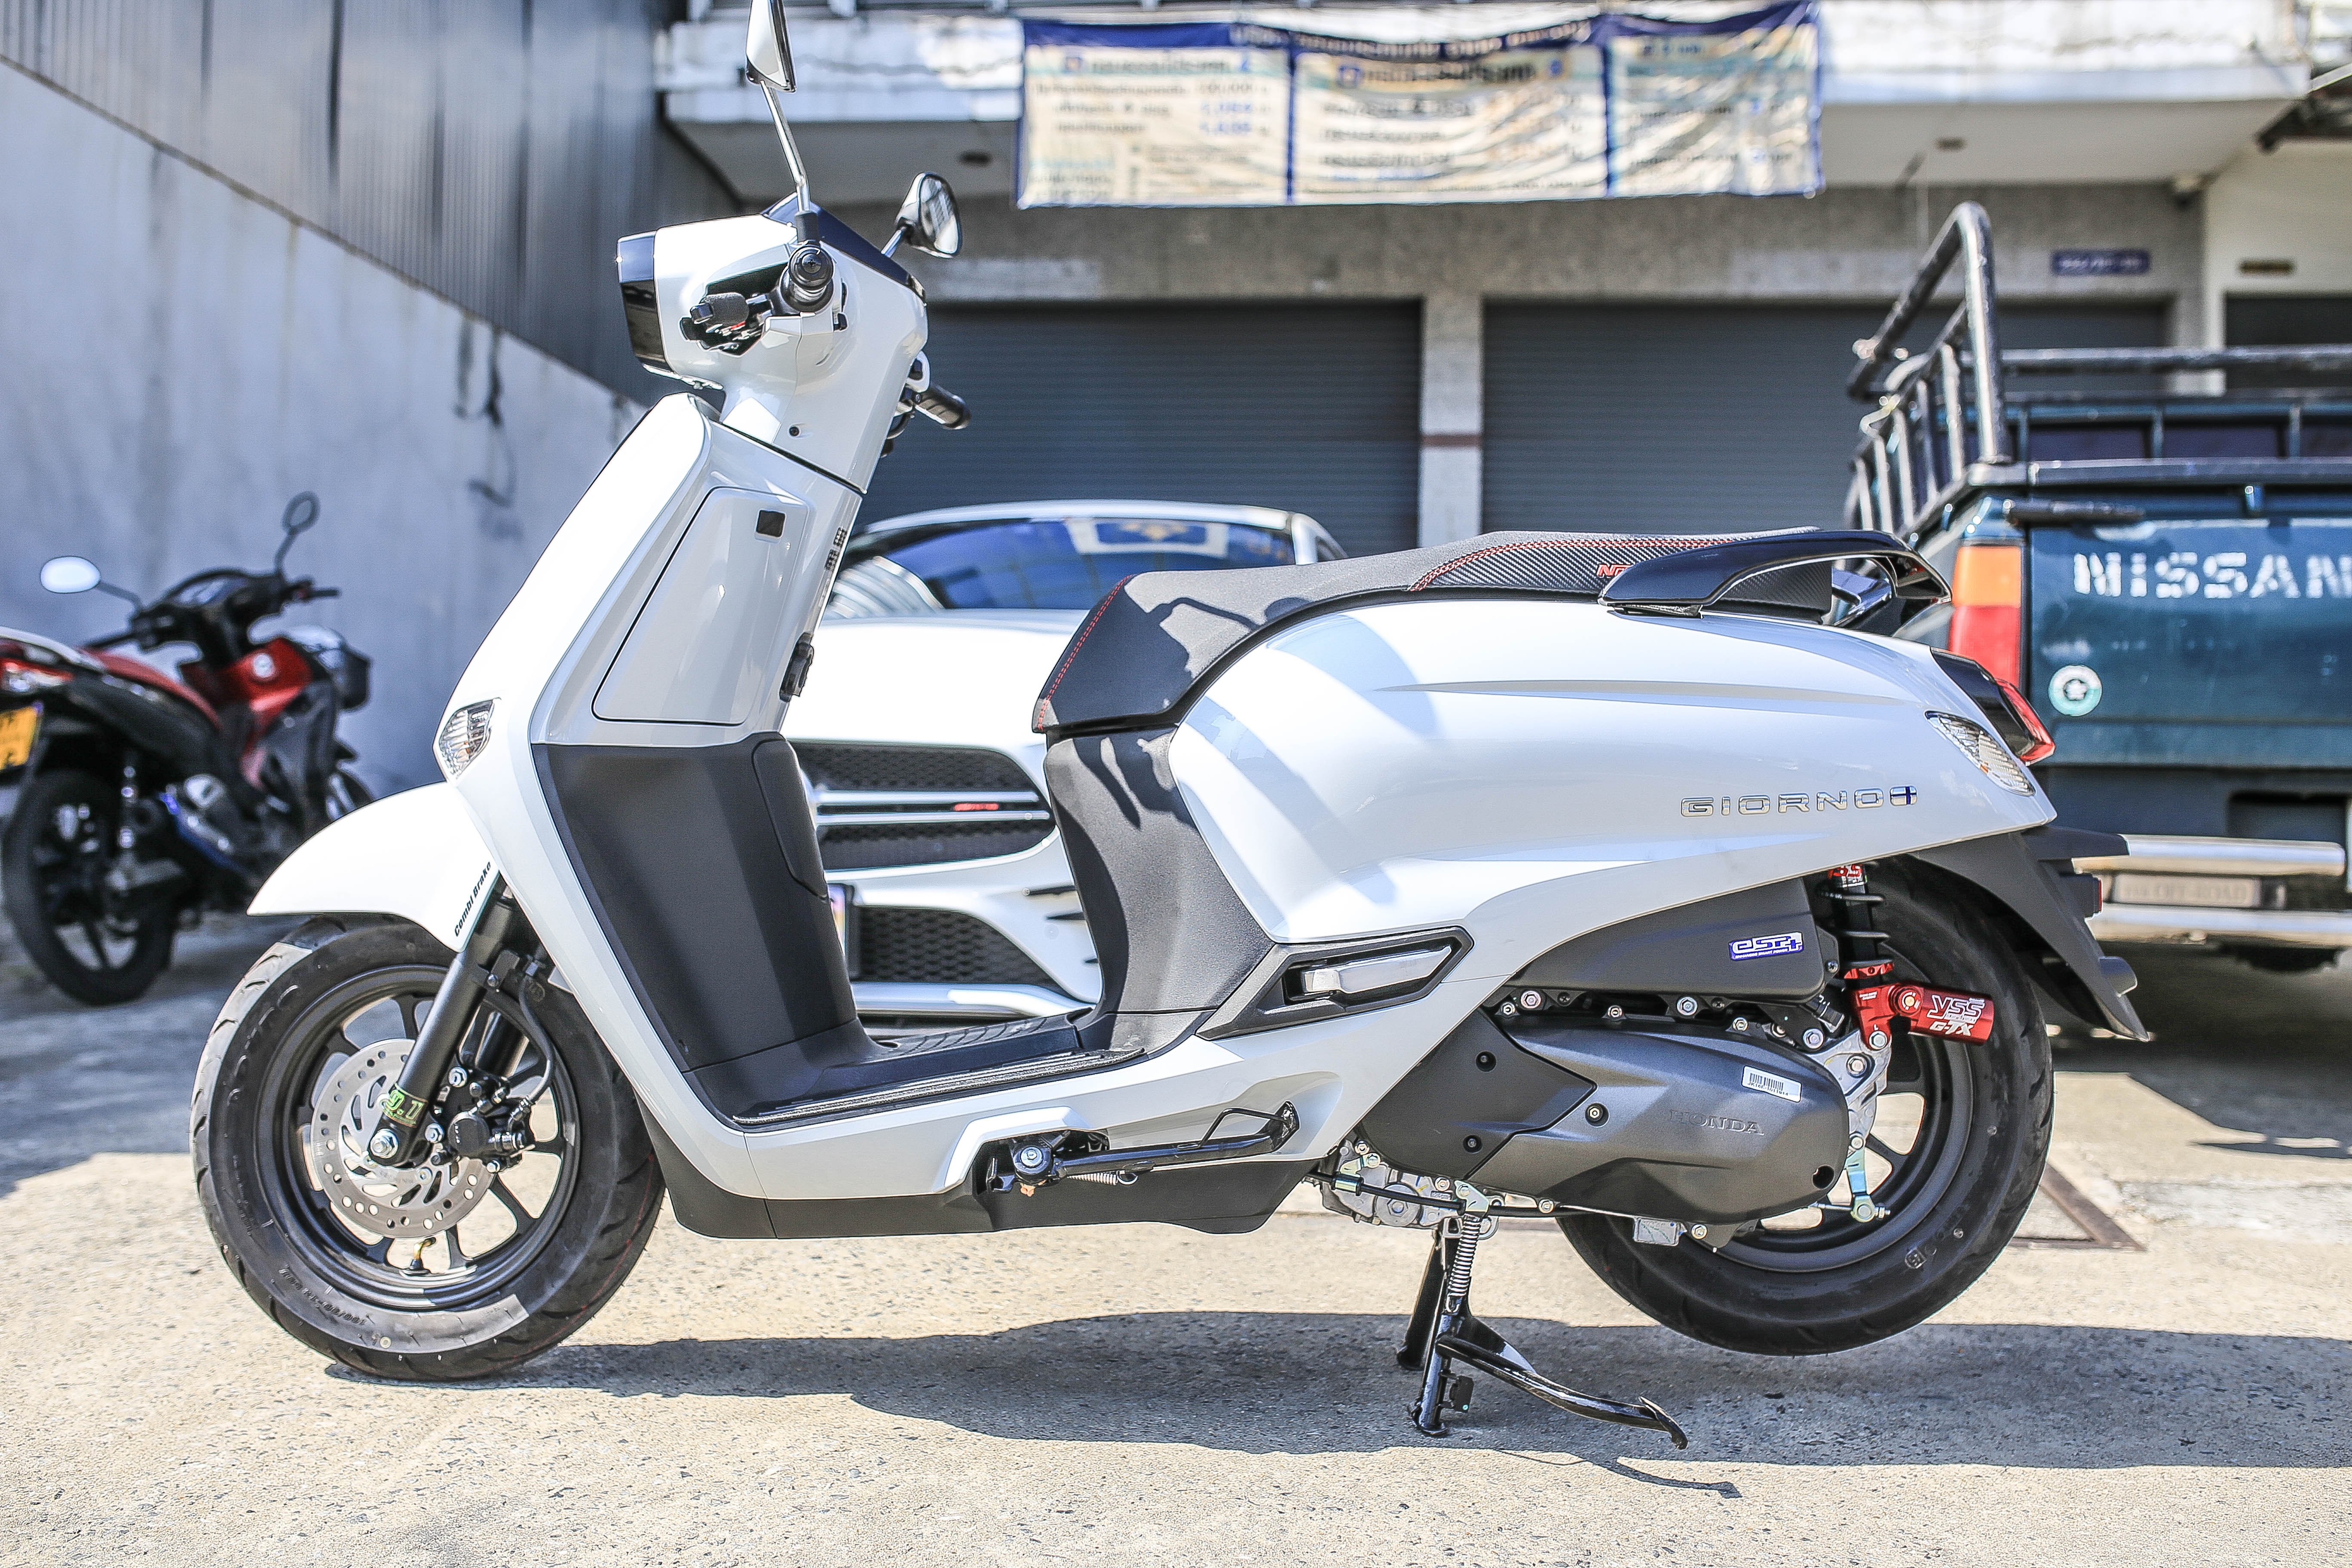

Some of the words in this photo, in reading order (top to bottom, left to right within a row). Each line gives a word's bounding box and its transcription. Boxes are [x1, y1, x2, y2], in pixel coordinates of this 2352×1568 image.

[2074, 552, 2352, 599] NISSAN
[1926, 995, 1985, 1020] YSS
[1668, 1109, 1765, 1136] HONDA
